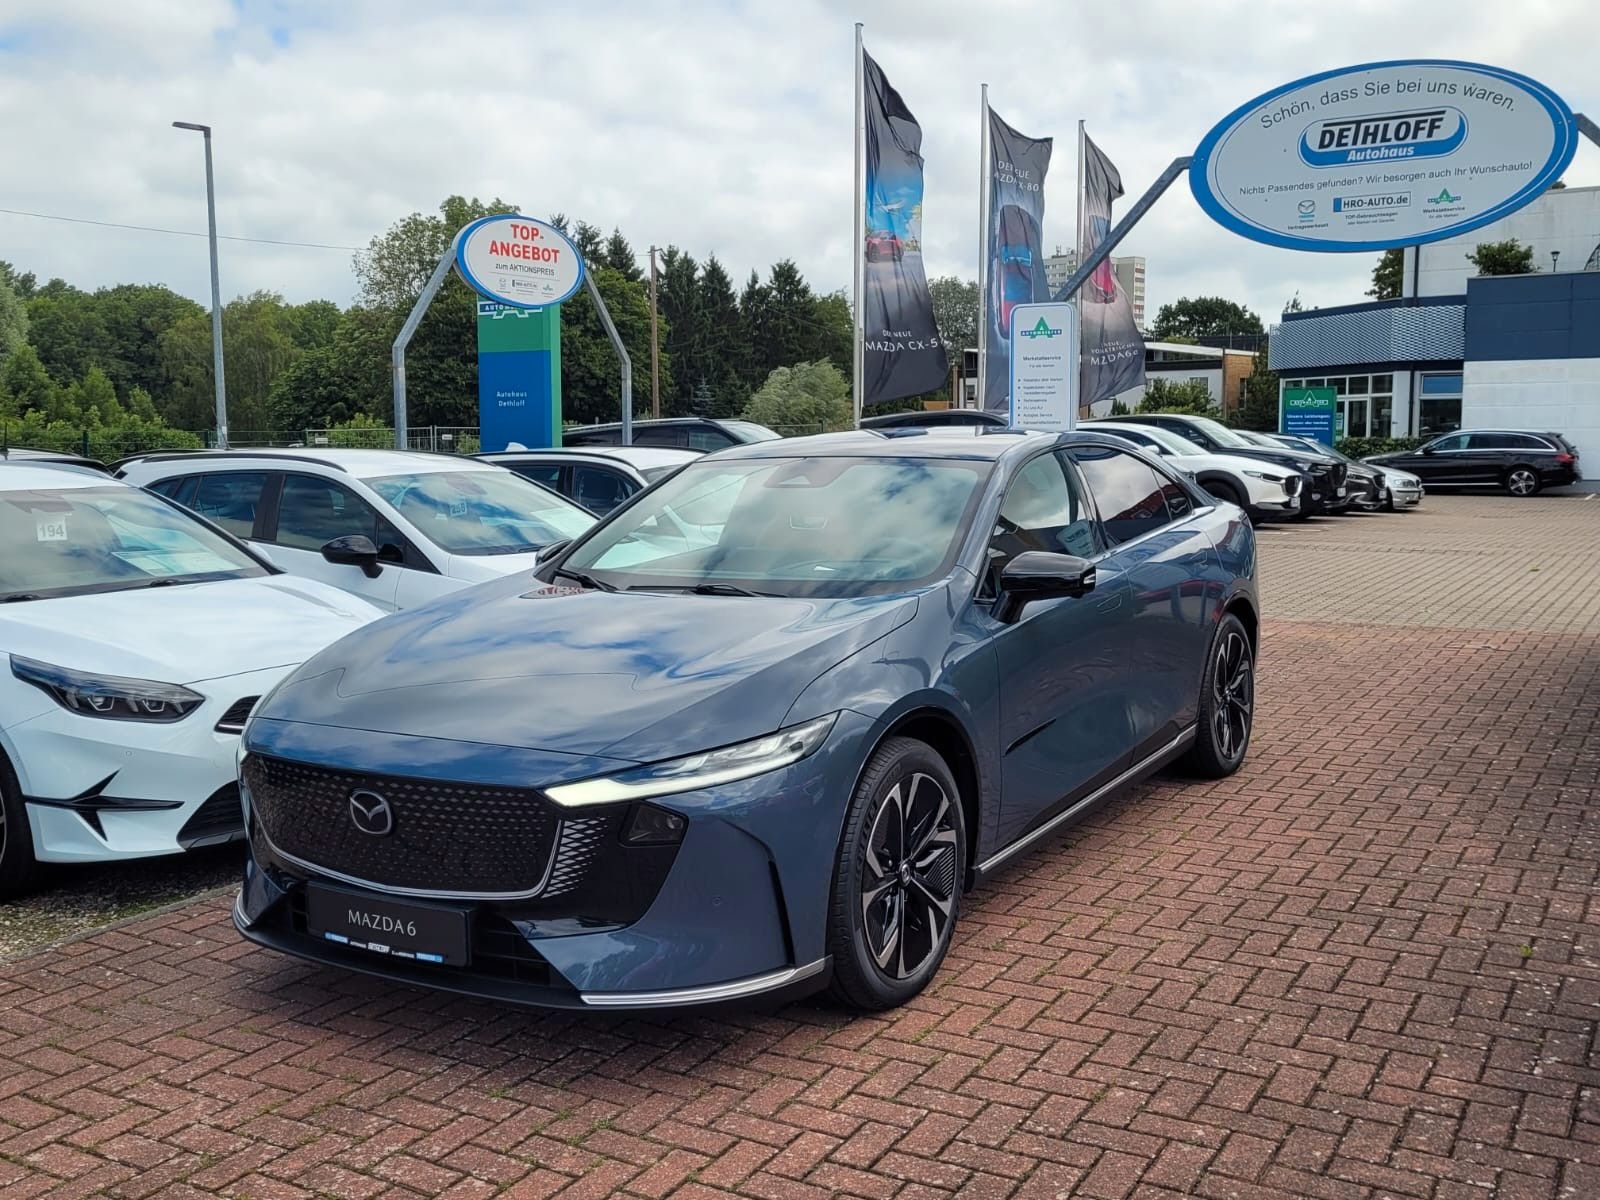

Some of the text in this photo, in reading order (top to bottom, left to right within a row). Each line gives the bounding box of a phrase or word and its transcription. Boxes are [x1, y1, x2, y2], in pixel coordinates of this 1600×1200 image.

[1261, 79, 1514, 129] Schön, dass Sie bei uns waren.
[1318, 110, 1446, 149] DETHLOFF
[1347, 146, 1414, 162] Autohaus
[1240, 161, 1532, 195] Nichts Passendes gefunden? Wir besorgen auch Ihr Wunschauto!
[1343, 195, 1408, 209] HRO-AUTO.de
[510, 224, 544, 241] TOP-
[489, 240, 560, 263] ANGEBOT
[509, 264, 555, 276] AKTIONSPREIS
[865, 338, 938, 352] MAZDA CX-5
[39, 524, 65, 537] 194
